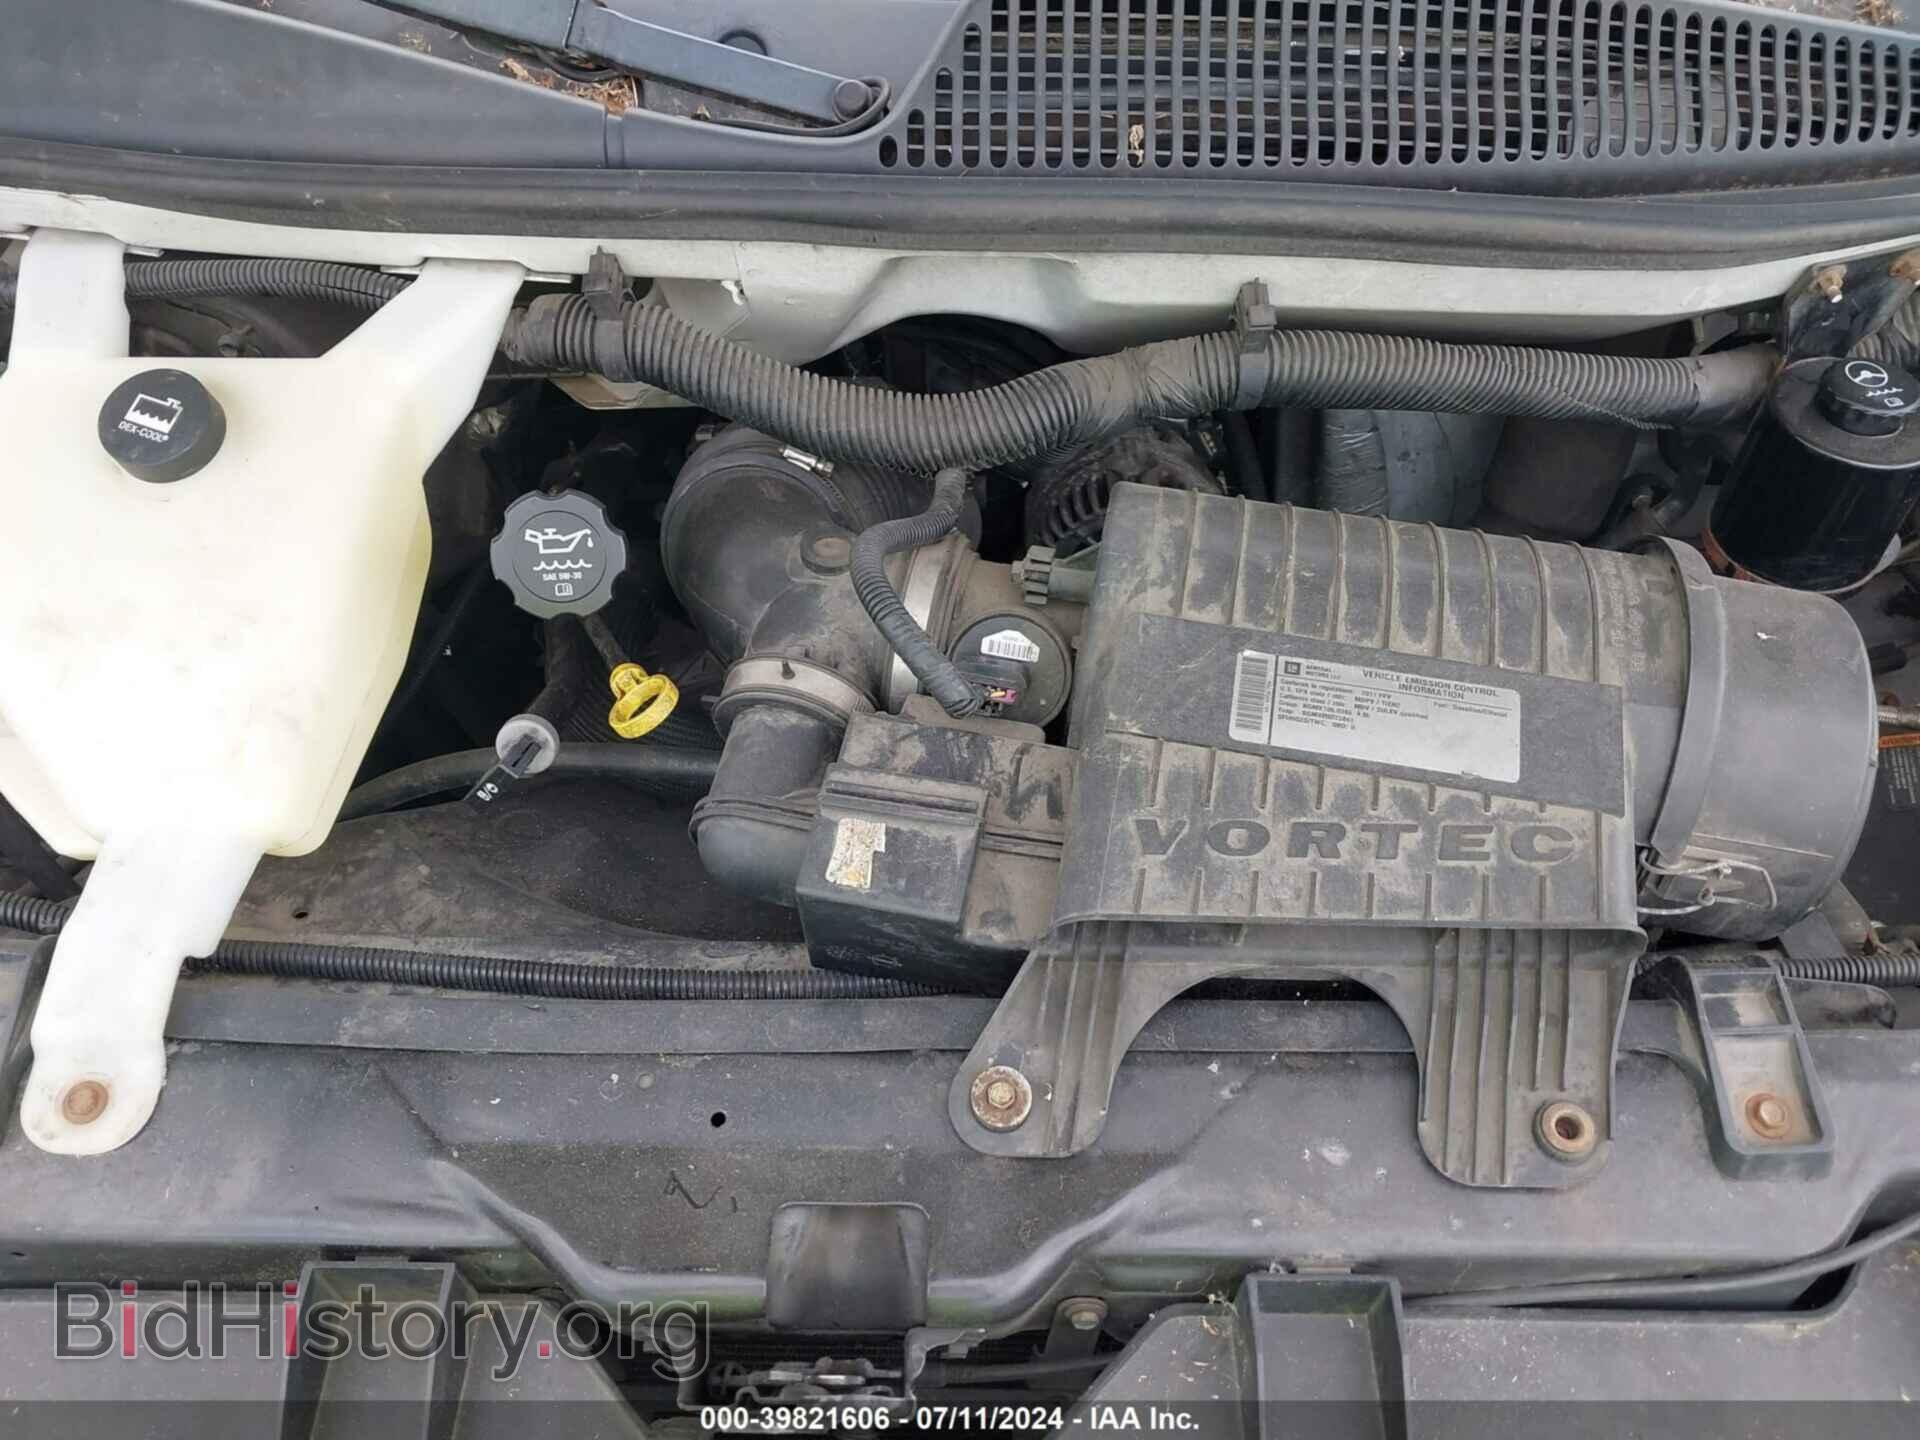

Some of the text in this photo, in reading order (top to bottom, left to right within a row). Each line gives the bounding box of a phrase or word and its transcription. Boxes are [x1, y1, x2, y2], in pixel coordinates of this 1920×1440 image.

[1362, 669, 1498, 697] VEHICLE EMISSION CONTROL
[1399, 683, 1465, 700] INFORMATION
[1133, 817, 1576, 864] VORTEC
